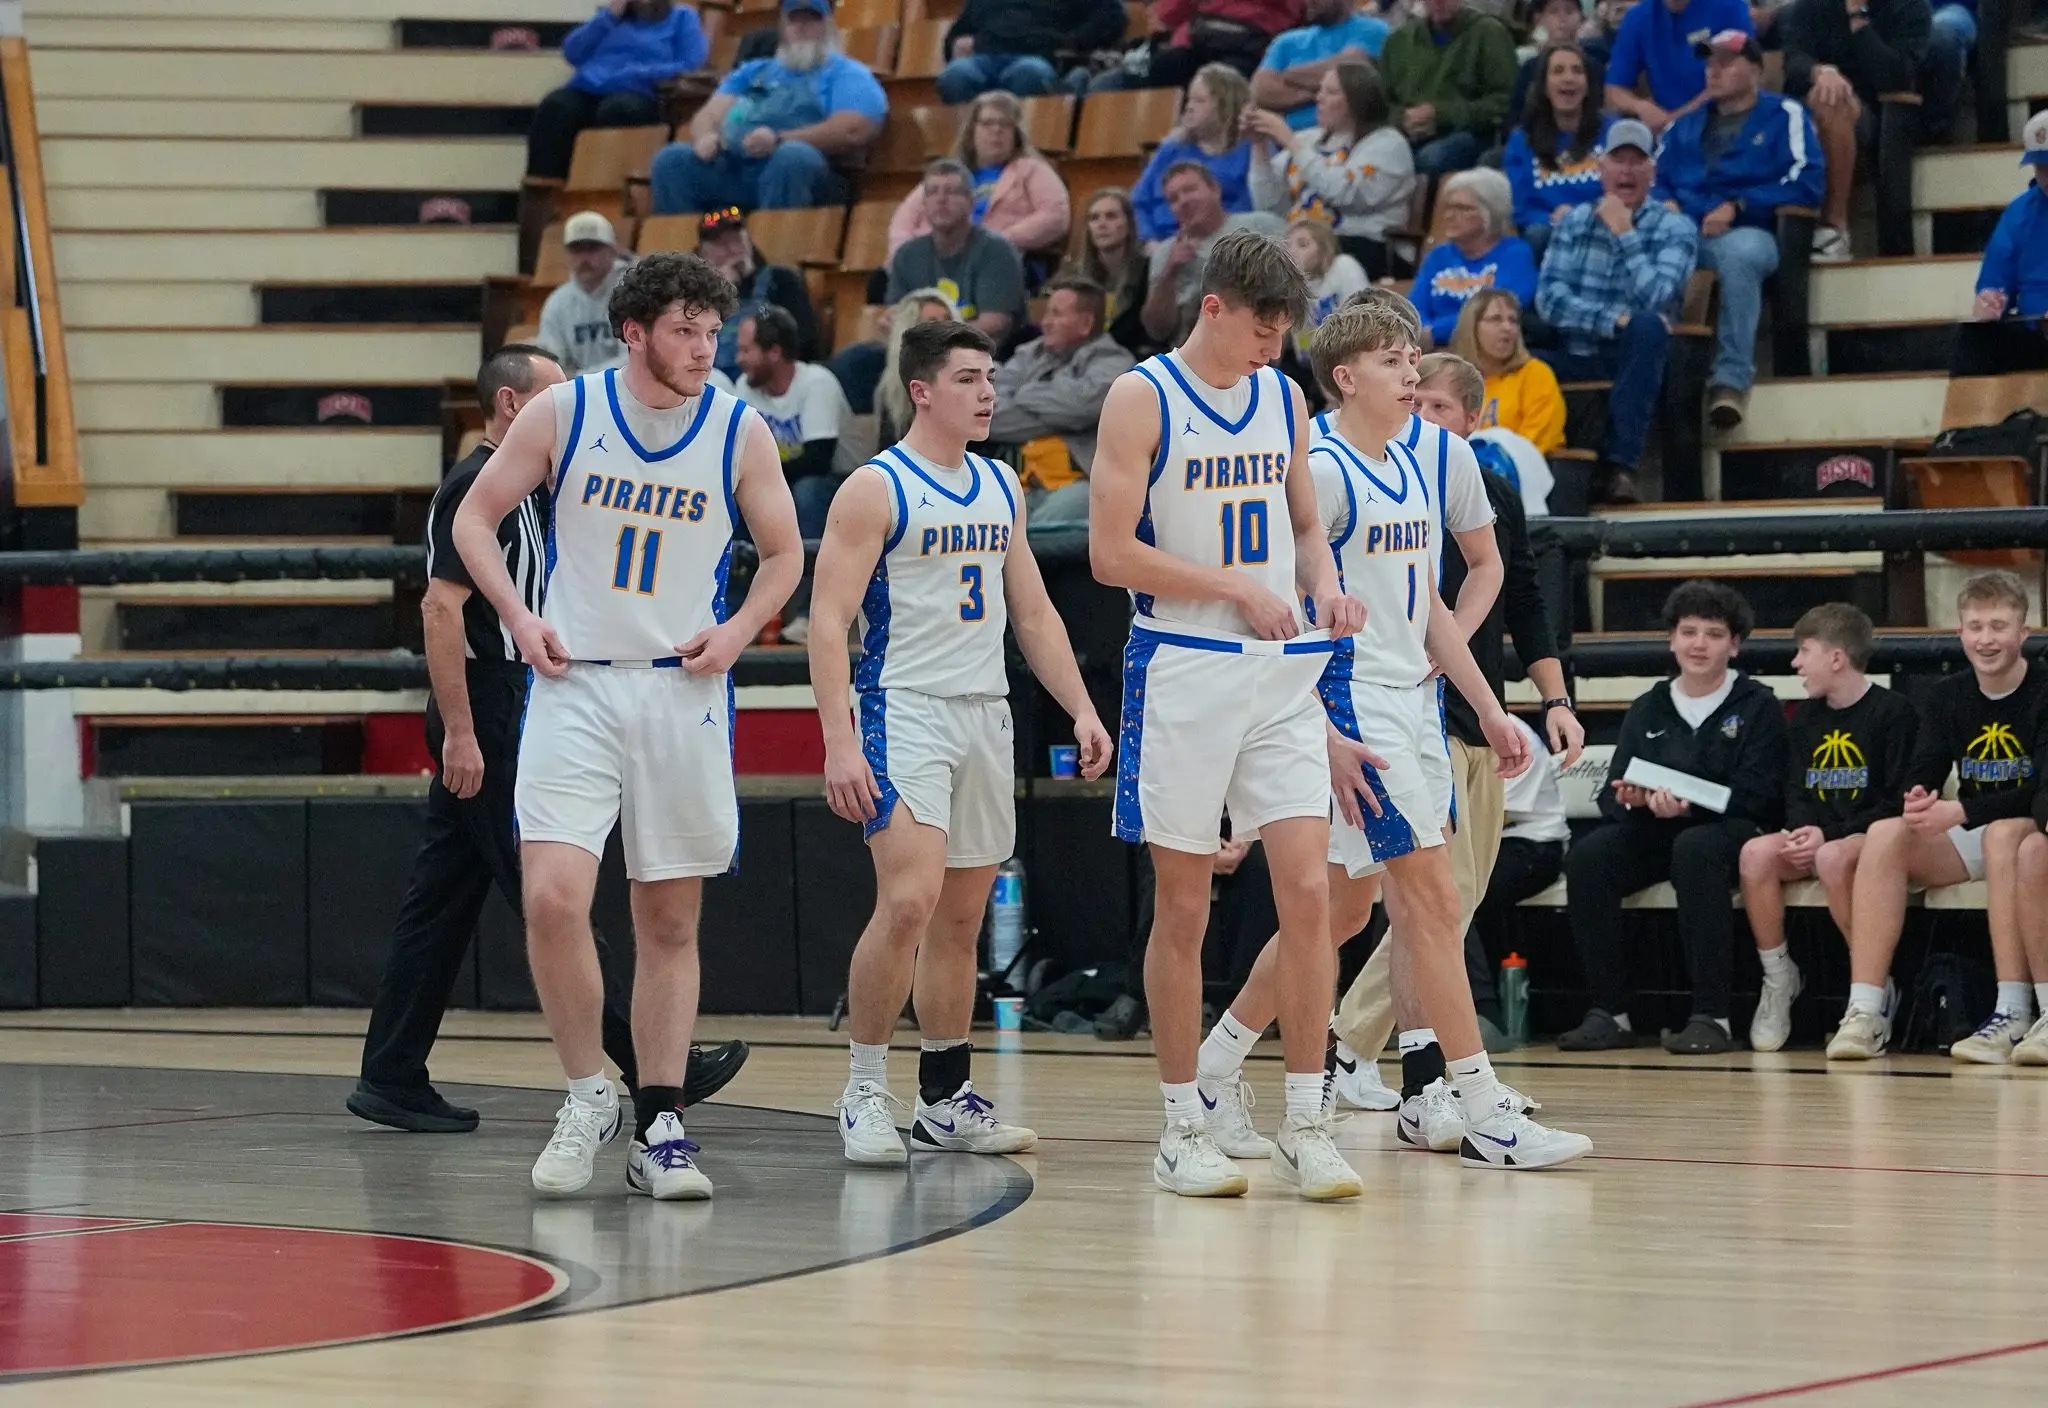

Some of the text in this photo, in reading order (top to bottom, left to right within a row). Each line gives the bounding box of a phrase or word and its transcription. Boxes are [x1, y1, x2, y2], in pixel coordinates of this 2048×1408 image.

[1184, 452, 1286, 491] PIRATES
[581, 472, 709, 523] PIRATES
[920, 523, 1010, 557] PIRATES
[1219, 498, 1269, 568] 10
[1366, 520, 1429, 555] PIRATE
[611, 523, 664, 596] 11
[959, 563, 986, 623] 3
[1407, 562, 1416, 624] 1
[1805, 766, 1868, 790] PIRATES
[1961, 756, 2035, 783] PIRATES
